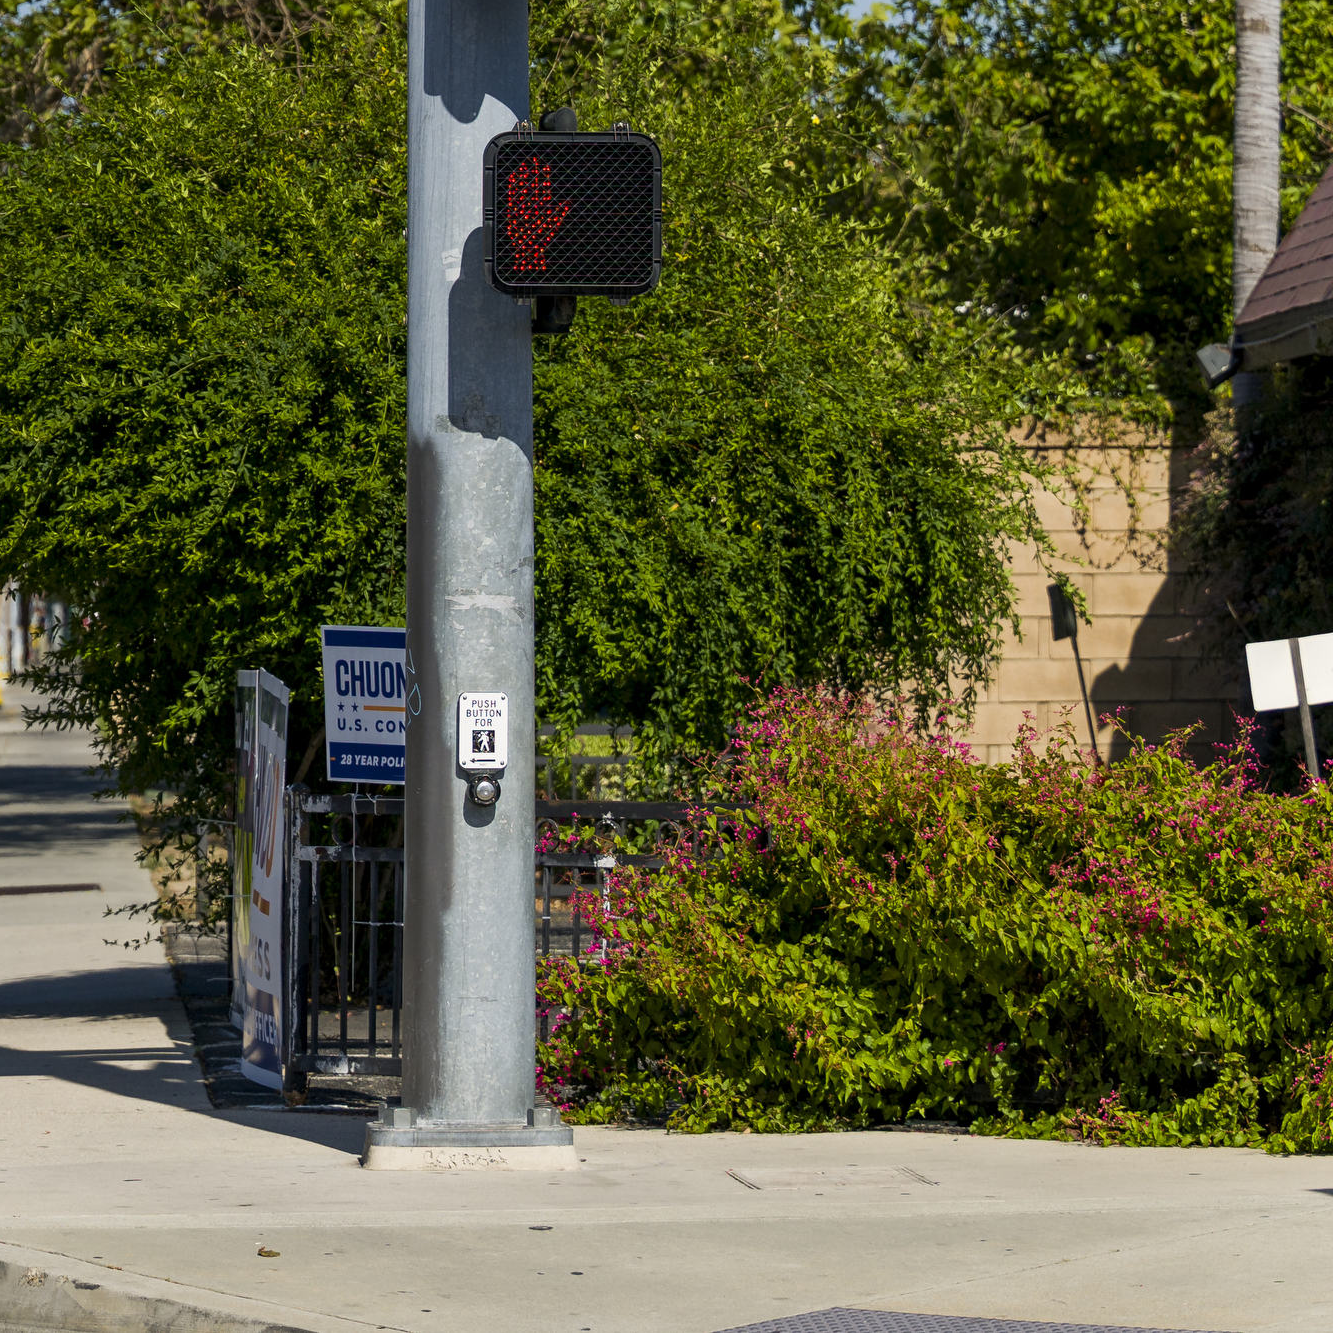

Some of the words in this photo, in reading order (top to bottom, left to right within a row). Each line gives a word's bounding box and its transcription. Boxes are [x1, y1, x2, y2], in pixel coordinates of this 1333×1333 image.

[471, 699, 497, 708] PUSH
[466, 709, 502, 718] BUTTON
[337, 718, 368, 732] U.S.
[474, 718, 493, 727] FOR
[340, 753, 353, 765] 28
[354, 754, 379, 767] YEAR
[380, 756, 406, 768] POLI
